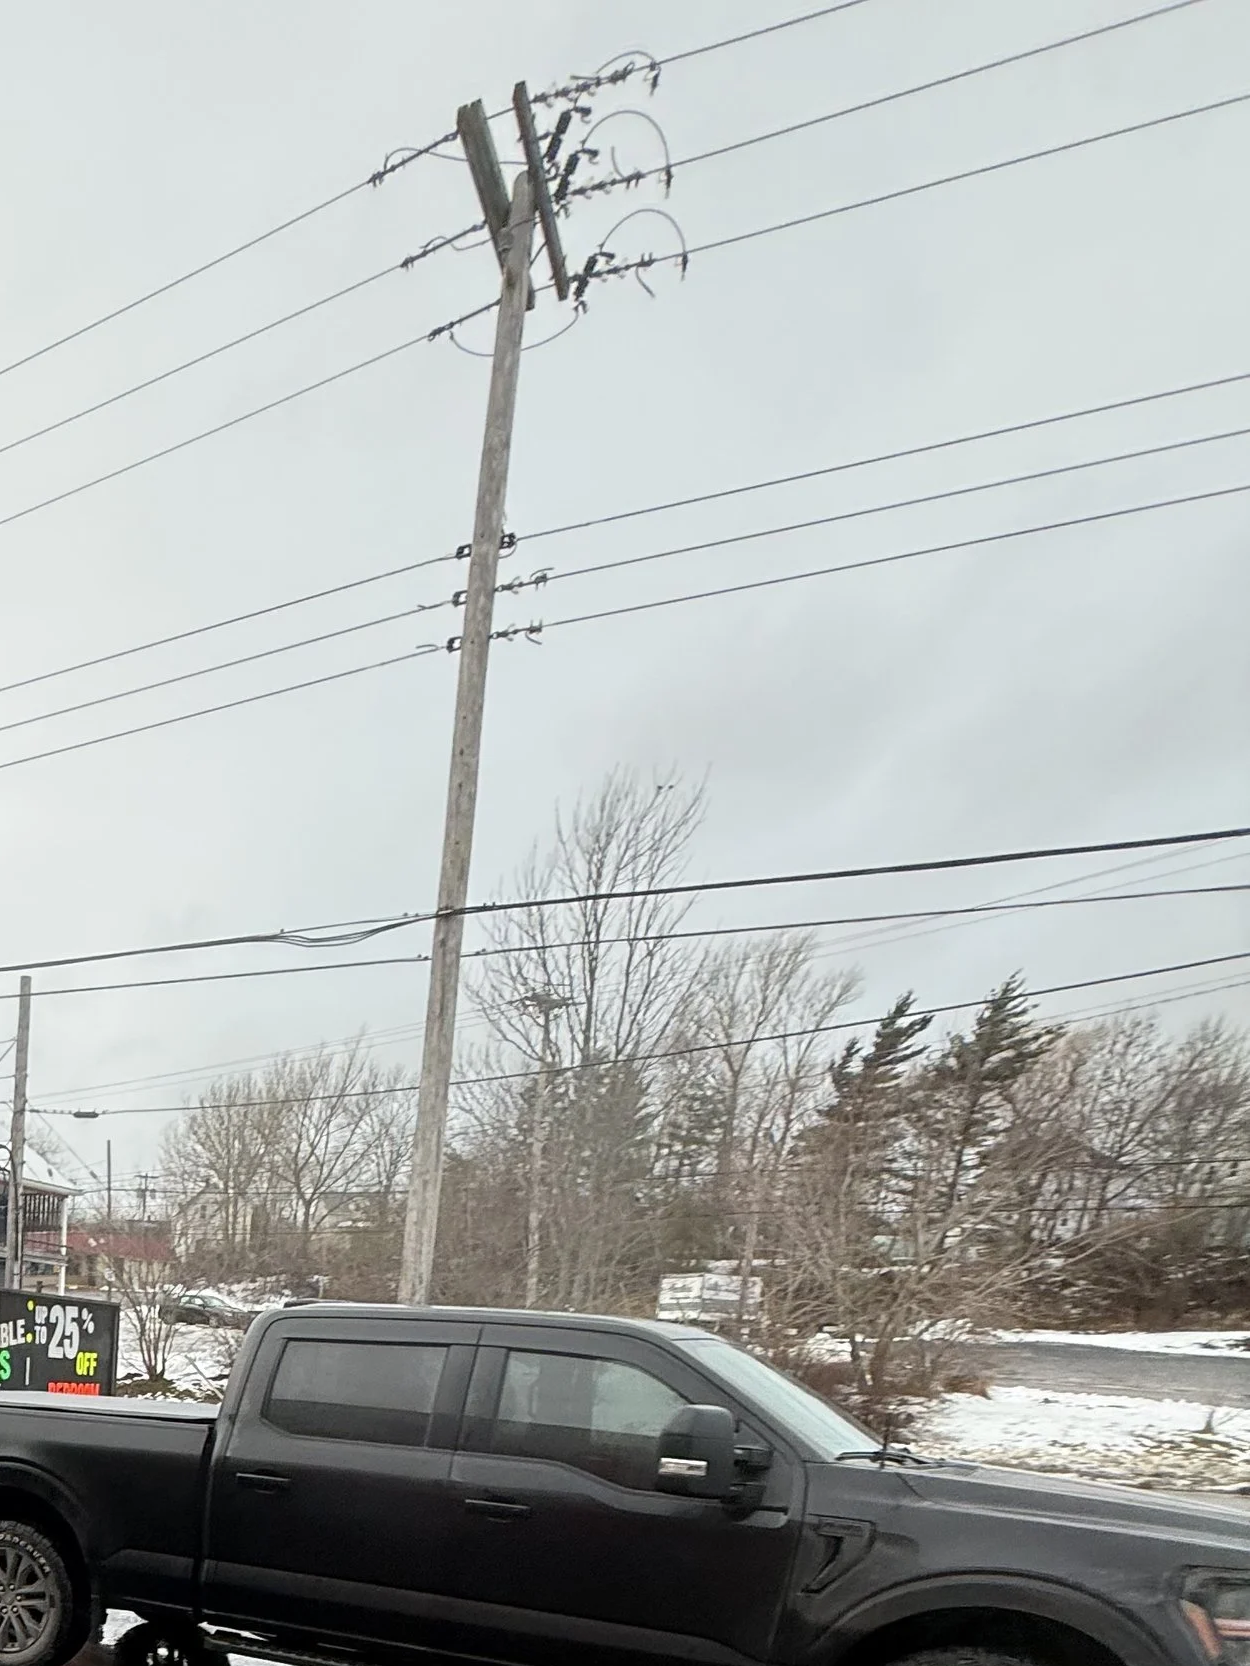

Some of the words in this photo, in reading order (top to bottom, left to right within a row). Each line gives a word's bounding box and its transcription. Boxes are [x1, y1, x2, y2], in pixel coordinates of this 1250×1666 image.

[34, 1305, 49, 1324] UP
[34, 1325, 47, 1345] TO
[75, 1352, 98, 1377] OFF
